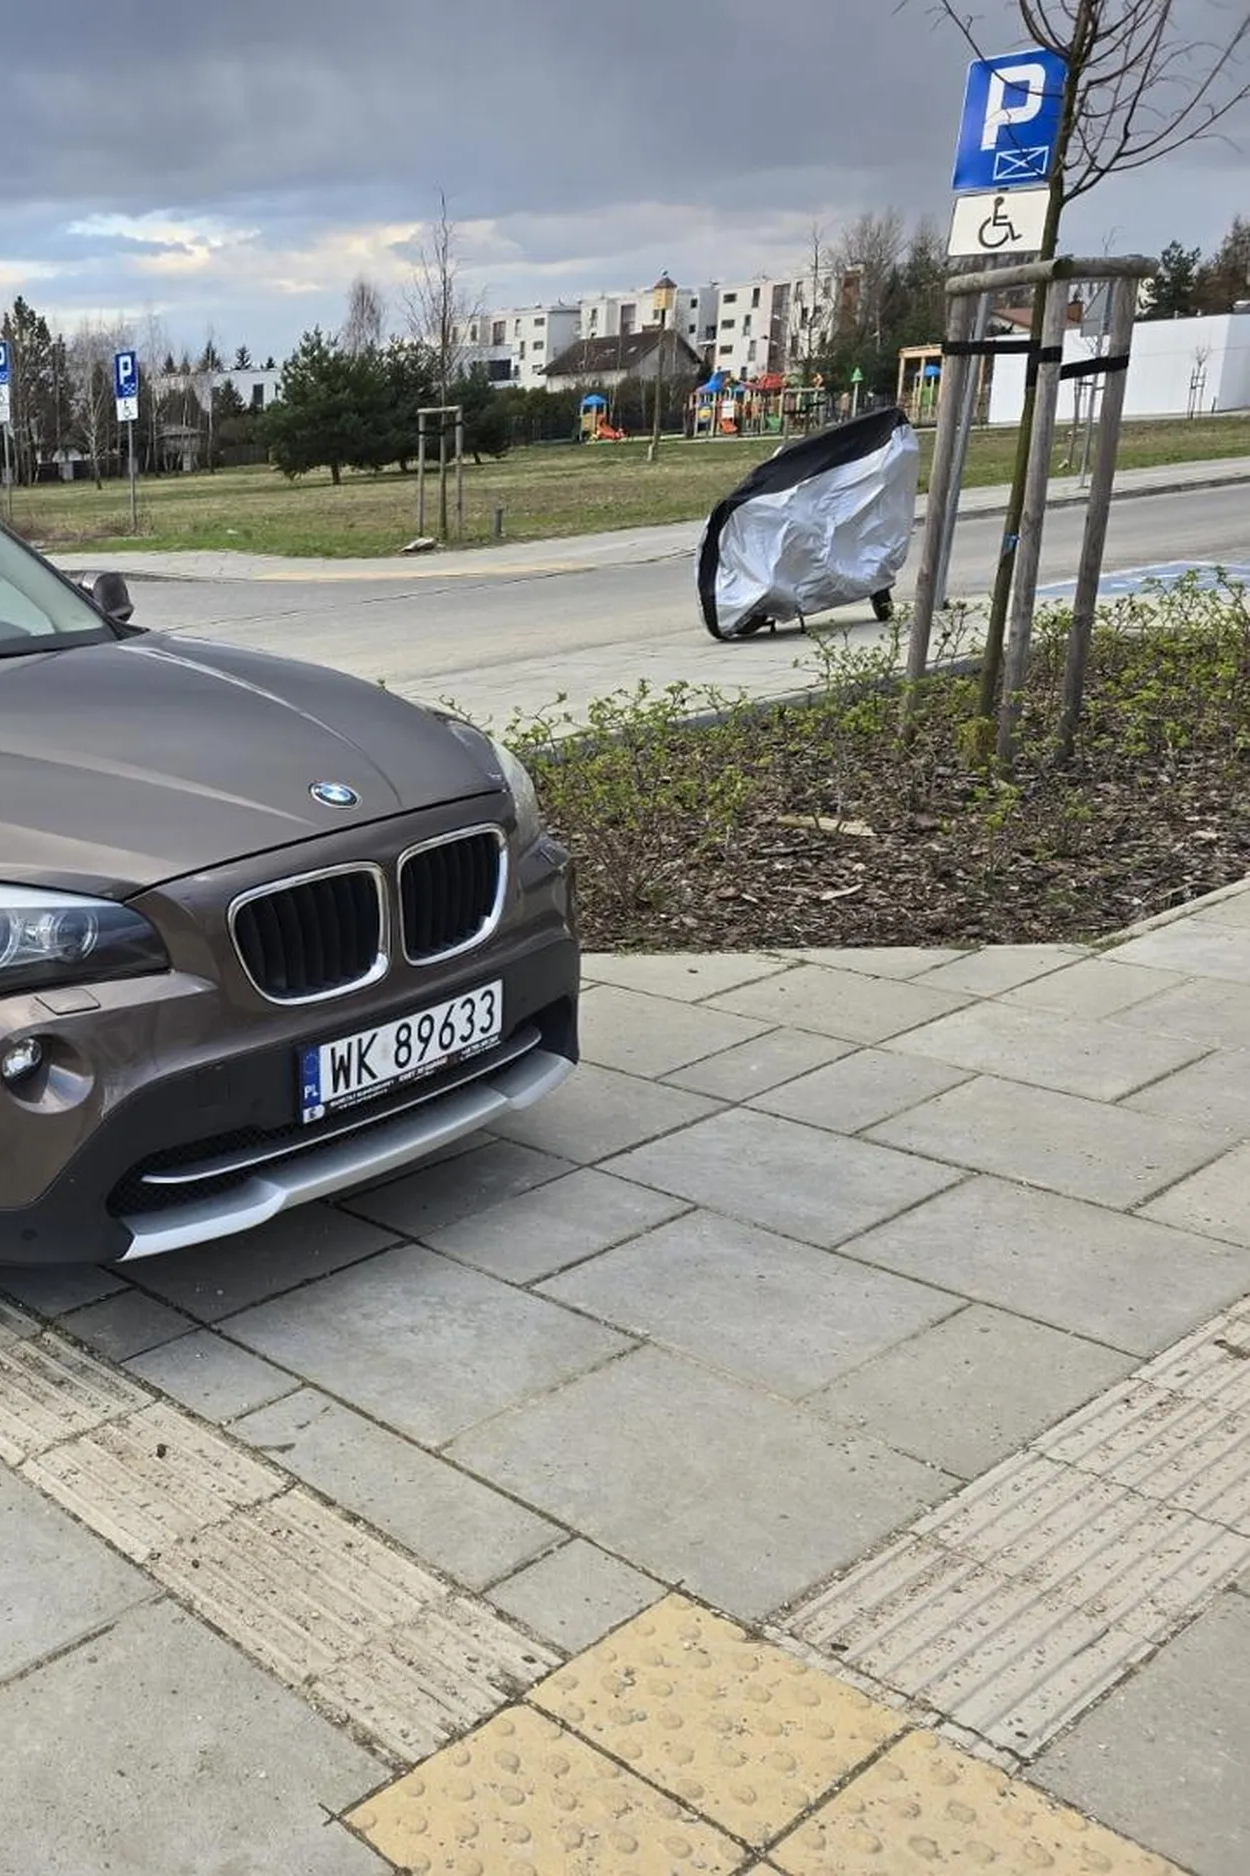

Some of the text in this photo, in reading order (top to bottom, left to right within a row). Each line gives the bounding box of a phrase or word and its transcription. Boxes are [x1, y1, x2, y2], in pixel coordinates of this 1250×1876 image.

[981, 63, 1046, 150] P
[119, 355, 132, 385] P
[330, 989, 496, 1093] WK 89633
[304, 1083, 319, 1099] PL
